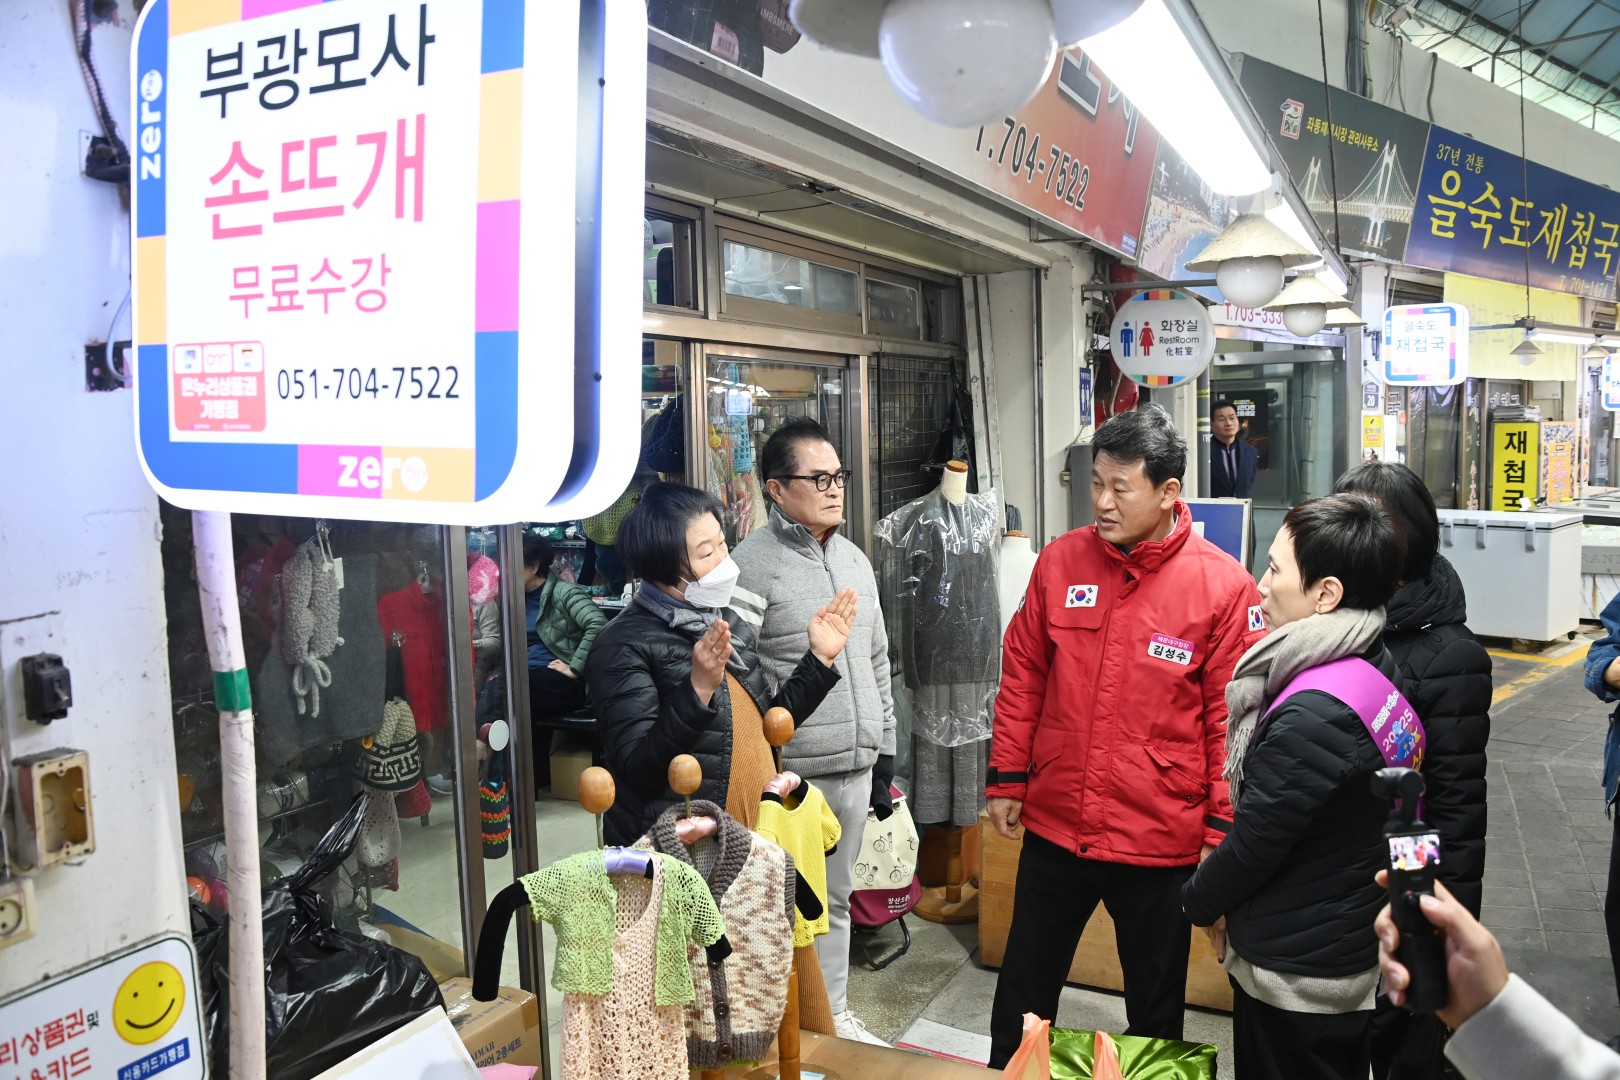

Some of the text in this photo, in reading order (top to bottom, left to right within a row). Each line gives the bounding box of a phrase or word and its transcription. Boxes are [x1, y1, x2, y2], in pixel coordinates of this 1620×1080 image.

[200, 3, 435, 118] 부광모사
[1348, 129, 1379, 152] 관리사무소
[1436, 143, 1485, 175] 37년 전통
[204, 113, 426, 240] 손뜨개
[1428, 170, 1620, 276] 을숙도재첩국
[229, 253, 392, 318] 무료수강
[1225, 302, 1284, 325] T.703-333
[1161, 319, 1198, 333] 화장실
[1404, 320, 1437, 333] 을숙도
[1158, 335, 1200, 345] RestRoom
[1396, 336, 1446, 353] 재첩국
[276, 365, 460, 400] 051-704-7522
[1366, 394, 1376, 407] 20
[1153, 644, 1187, 662] 김성수
[86, 1011, 100, 1031] 및
[496, 1037, 523, 1061] 2종세트
[122, 1044, 186, 1080] 신용카드가맹점
